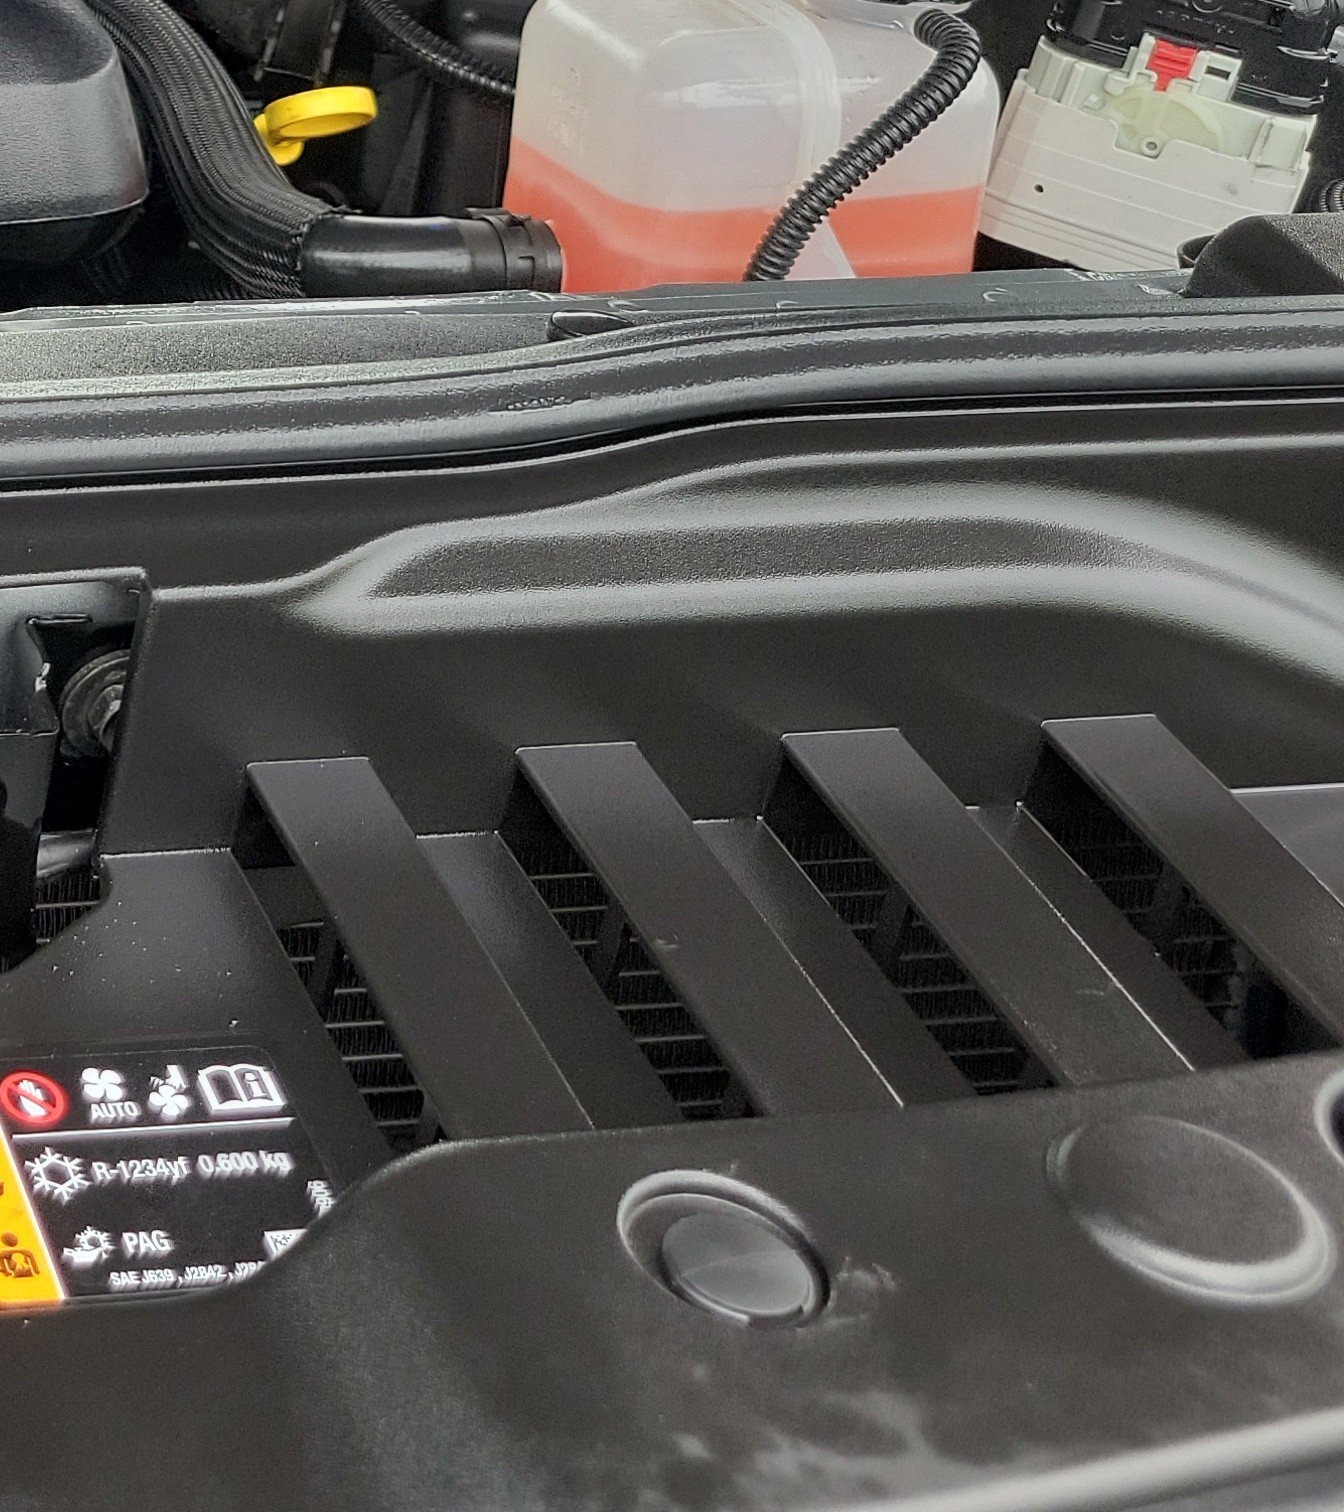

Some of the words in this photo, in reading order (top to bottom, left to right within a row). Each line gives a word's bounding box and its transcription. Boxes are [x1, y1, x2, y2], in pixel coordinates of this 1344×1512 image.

[90, 1100, 140, 1121] AUTO
[91, 1155, 190, 1184] R-1234yf
[197, 1150, 258, 1176] 0.600
[258, 1149, 296, 1175] kg
[122, 1230, 173, 1255] PAG
[110, 1271, 141, 1286] SAE
